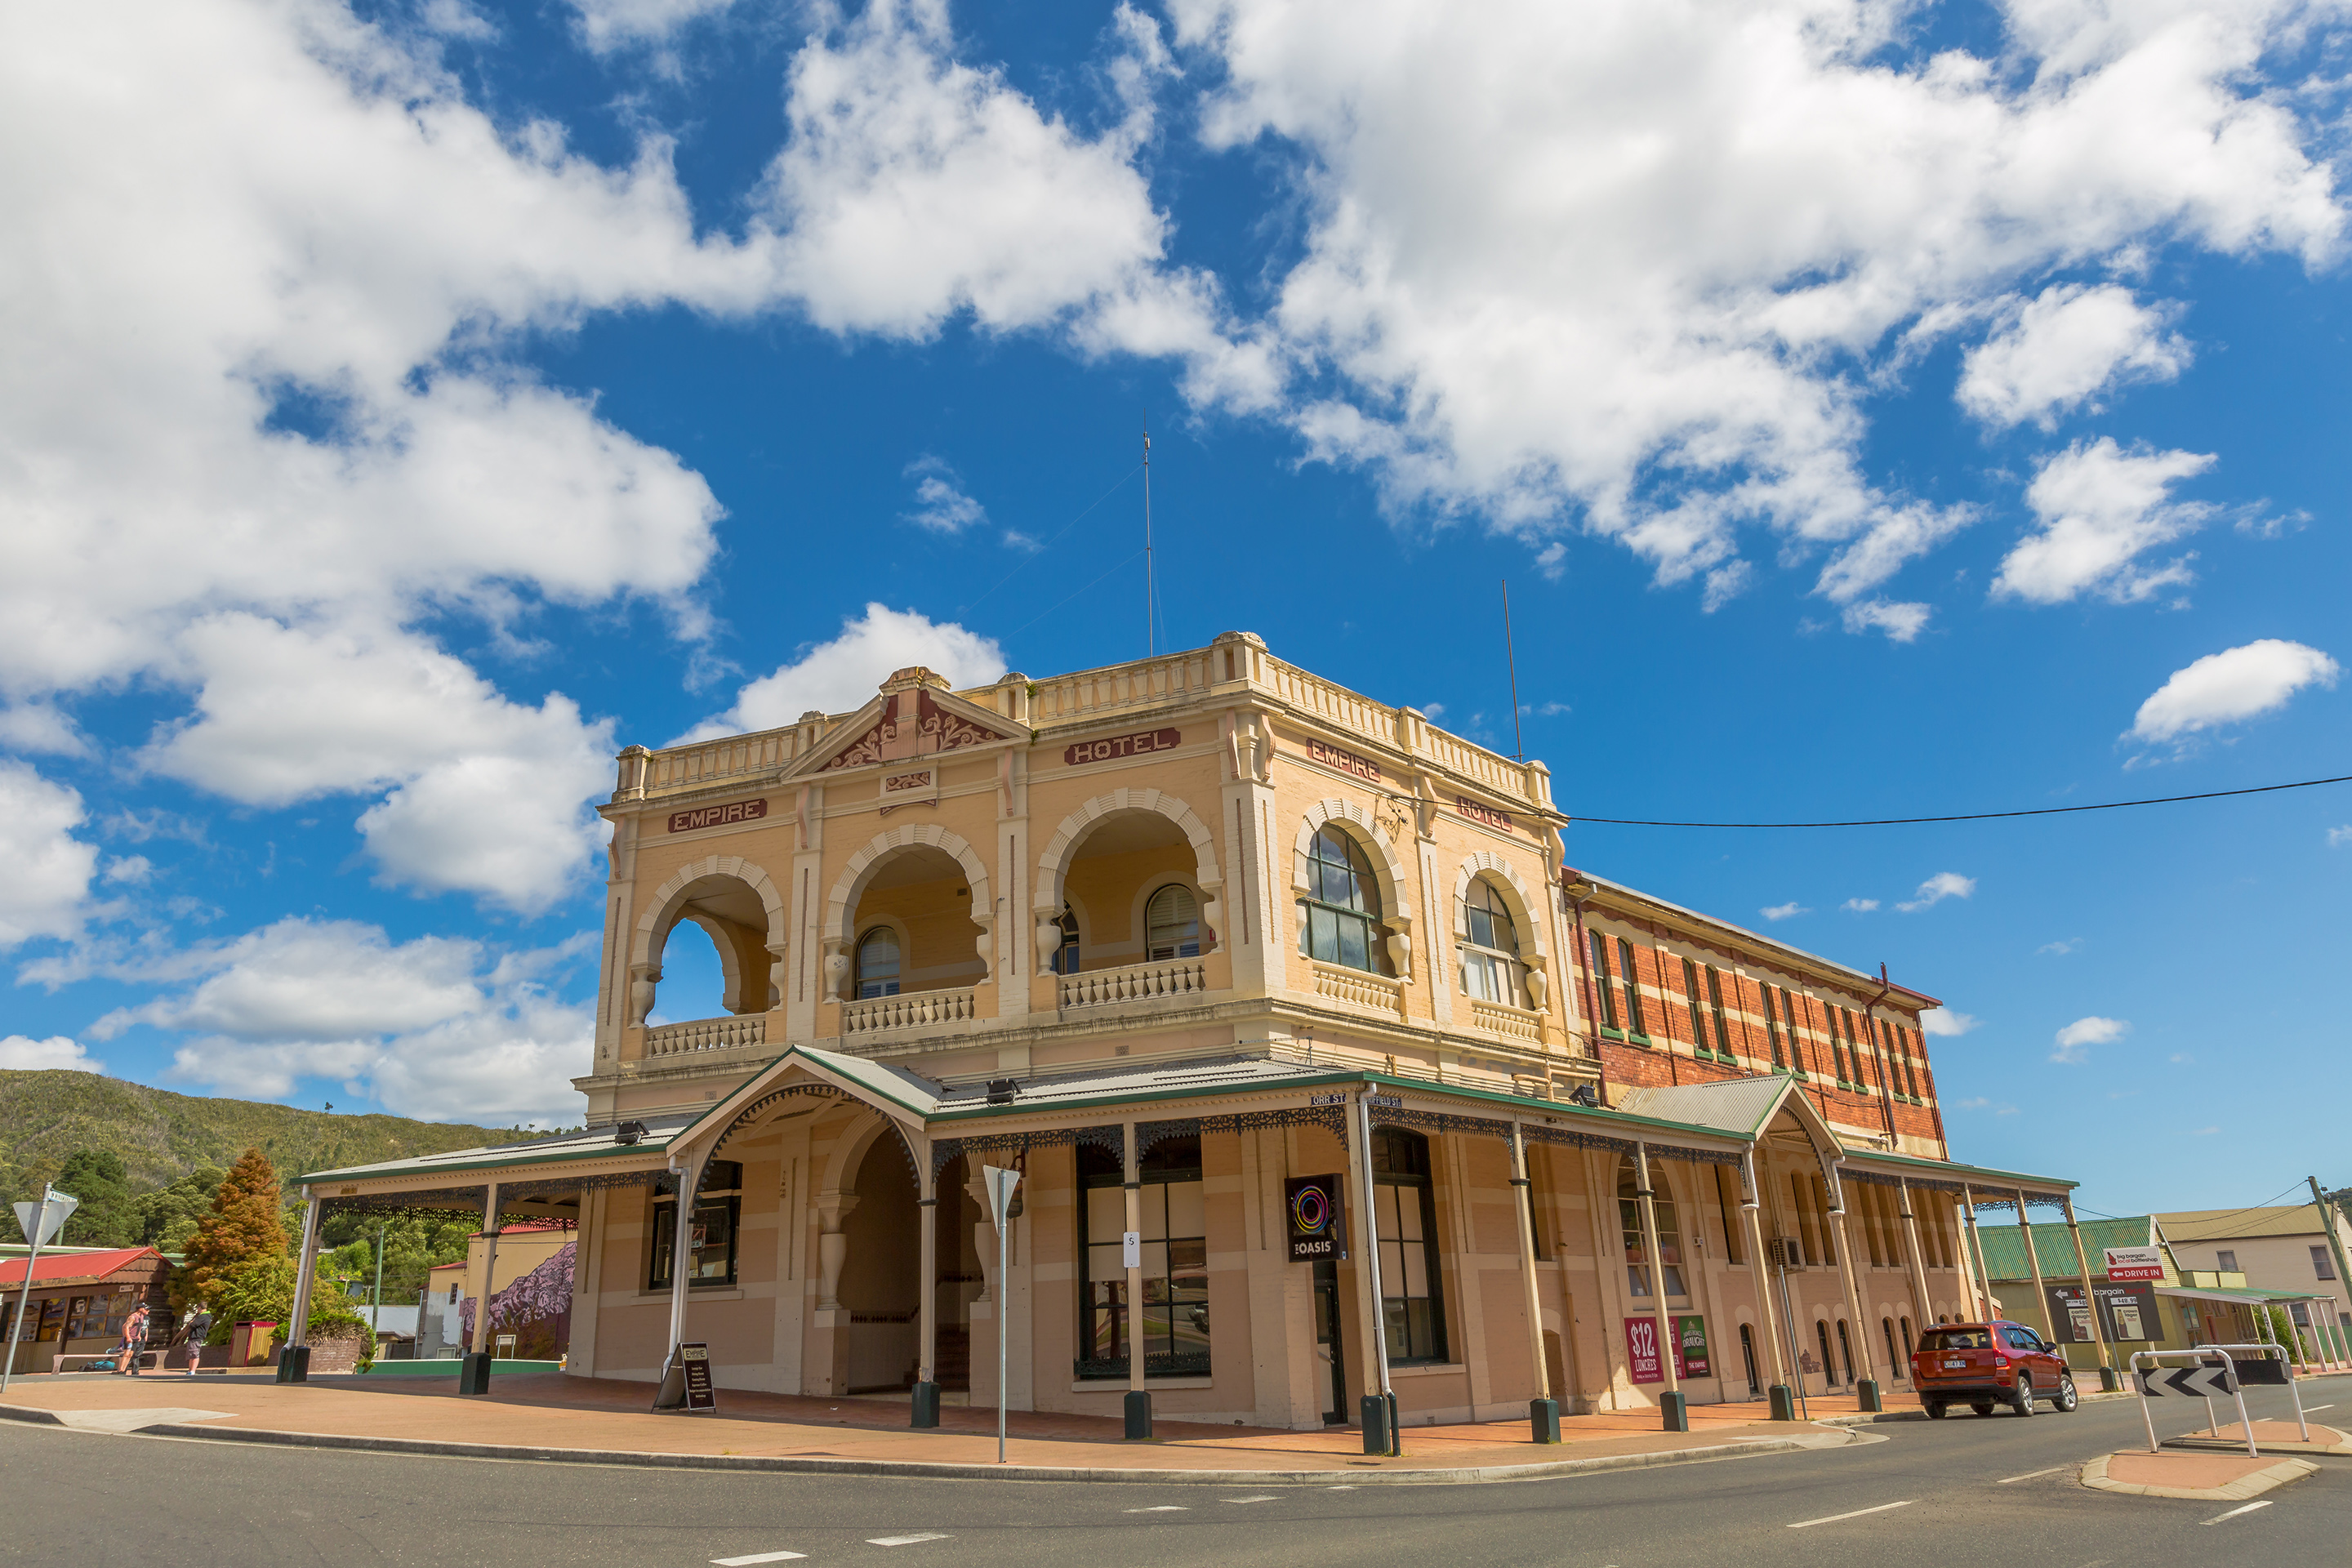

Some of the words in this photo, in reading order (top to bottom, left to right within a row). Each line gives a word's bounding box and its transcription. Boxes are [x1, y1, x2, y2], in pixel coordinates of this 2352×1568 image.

[1074, 731, 1172, 764] HOTEL
[1312, 740, 1380, 782] EMPIRE
[674, 800, 760, 831] EMPIRE
[1460, 798, 1510, 831] HOTEL
[1313, 1096, 1330, 1105] ORR
[1129, 1236, 1134, 1245] S
[1298, 1241, 1331, 1254] OASIS
[1631, 1322, 1655, 1357] $12
[1682, 1337, 1705, 1348] DRAUGHT
[1634, 1358, 1657, 1372] LUNCHES
